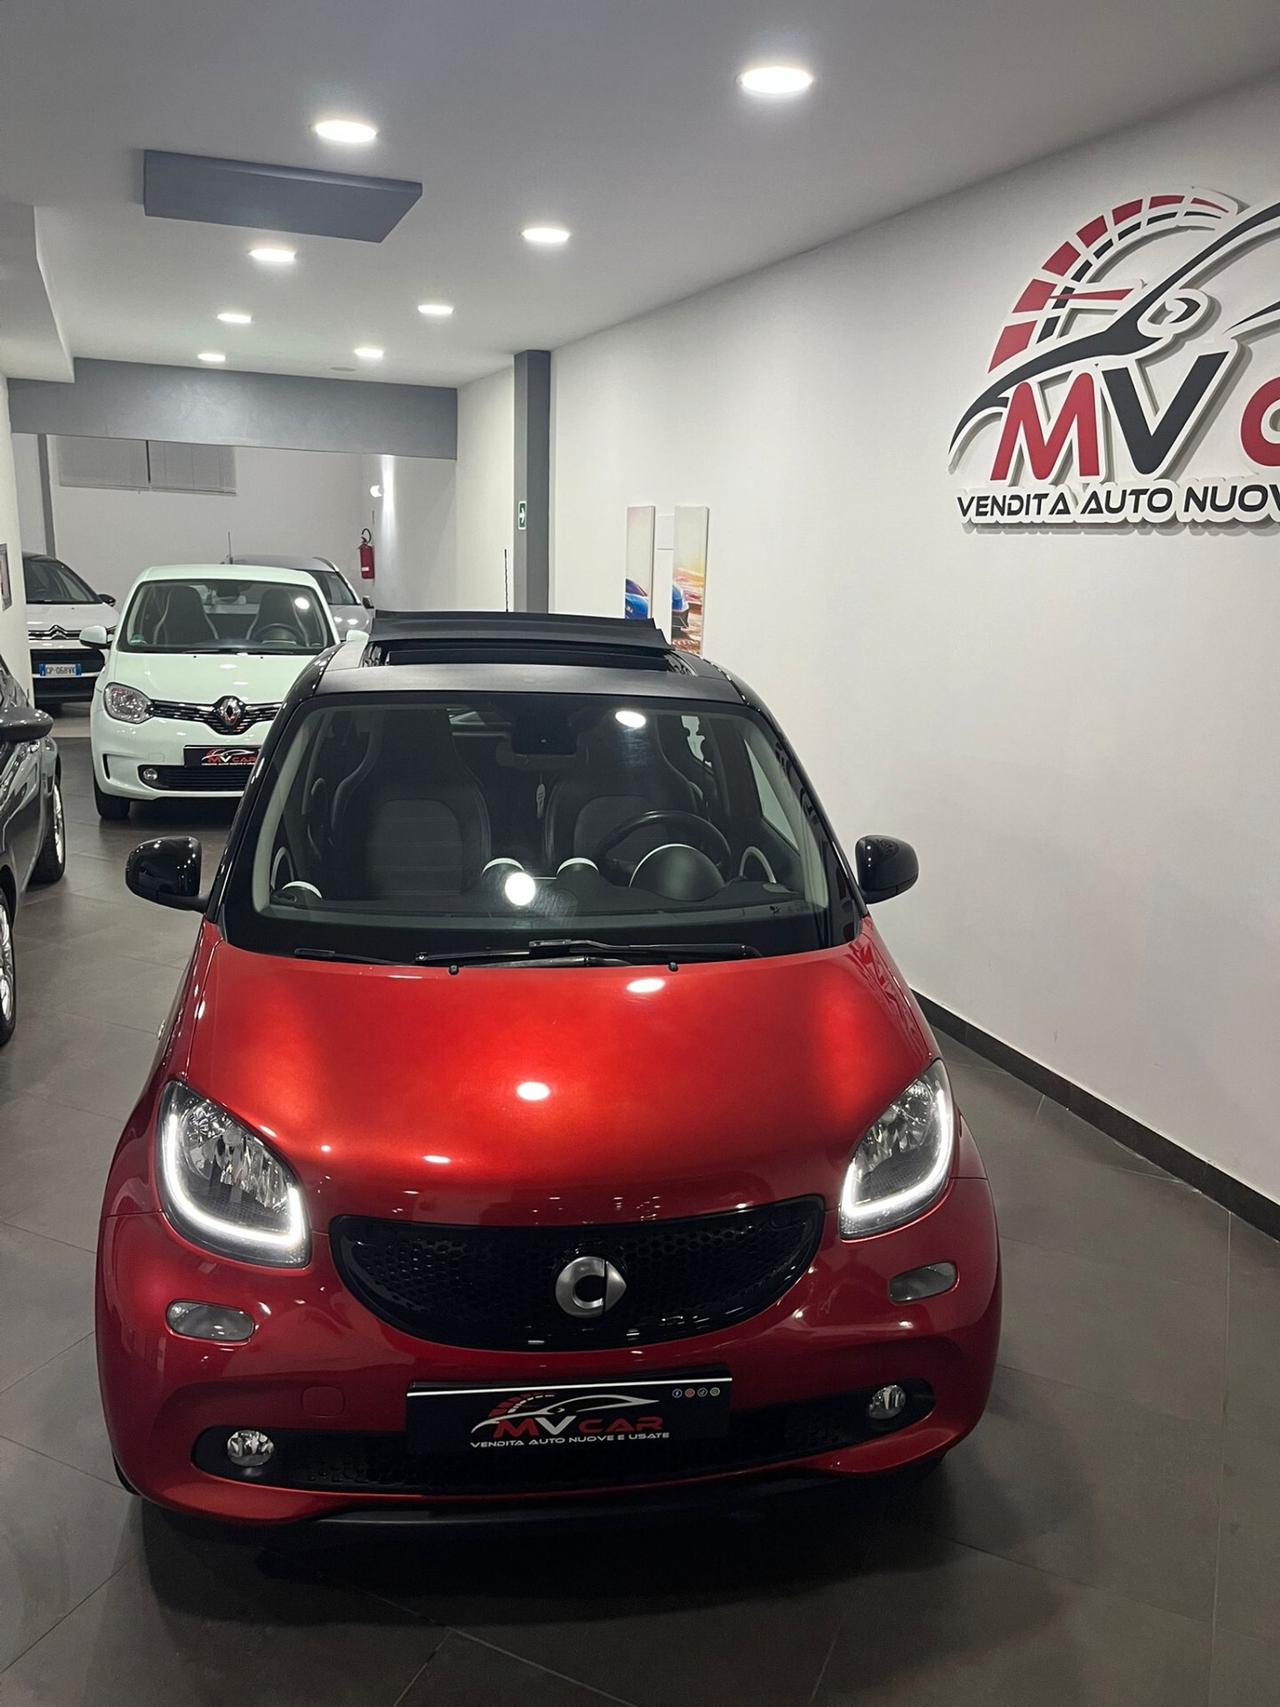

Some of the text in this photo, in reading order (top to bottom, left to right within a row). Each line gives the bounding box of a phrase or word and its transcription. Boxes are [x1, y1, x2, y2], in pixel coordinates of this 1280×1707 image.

[956, 492, 1071, 518] VENDITA
[1080, 487, 1173, 515] AUTO
[470, 1439, 525, 1448] VENDITA
[528, 1437, 566, 1446] AUTO
[568, 1434, 614, 1444] NUOVE
[628, 1432, 670, 1440] USATE
